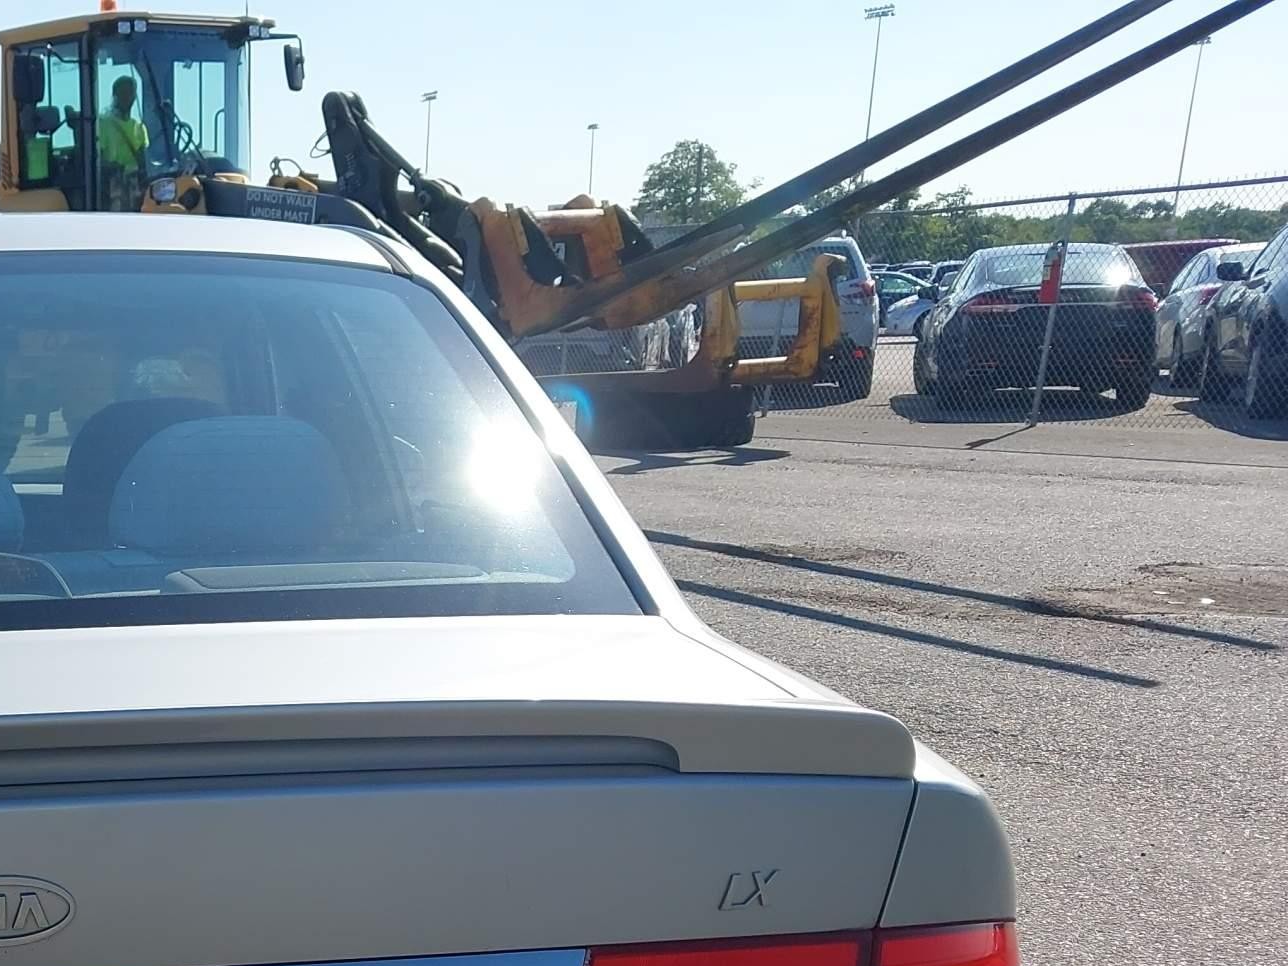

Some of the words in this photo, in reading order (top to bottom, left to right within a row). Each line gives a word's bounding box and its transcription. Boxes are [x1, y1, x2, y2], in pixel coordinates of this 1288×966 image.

[246, 191, 261, 201] DO
[264, 192, 284, 204] NOT
[286, 195, 313, 207] WALK
[251, 206, 282, 219] UNDER
[284, 209, 310, 222] MAST
[718, 868, 782, 911] LX
